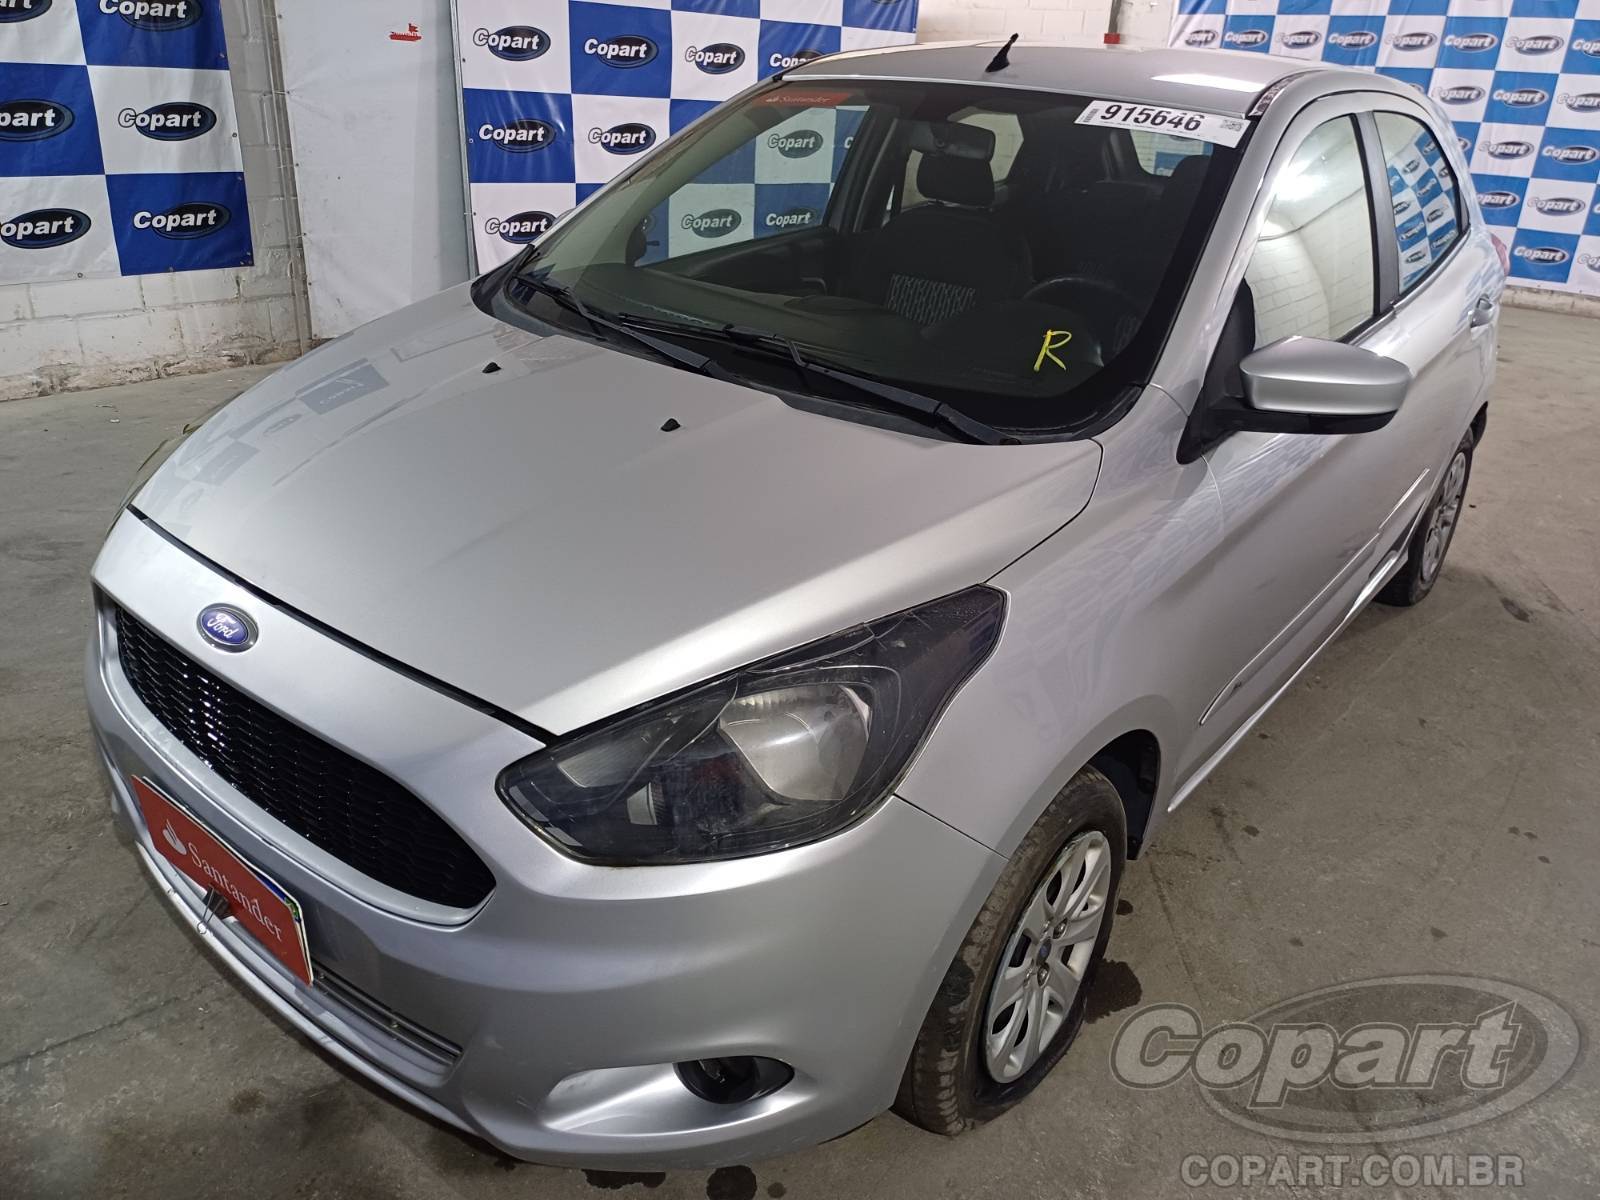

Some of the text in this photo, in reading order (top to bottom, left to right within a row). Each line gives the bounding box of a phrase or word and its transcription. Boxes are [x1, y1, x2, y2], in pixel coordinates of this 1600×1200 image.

[100, 0, 187, 19] Copart
[473, 28, 540, 50] Copart
[584, 38, 648, 59] Copart
[1329, 33, 1374, 46] Copart
[1445, 34, 1492, 48] Copart
[685, 46, 737, 65] Copart
[1493, 89, 1542, 104] Copart
[118, 108, 201, 131] Copart
[1100, 104, 1205, 131] 915646
[479, 124, 545, 142] Copart
[588, 127, 647, 146] Copart
[767, 133, 815, 149] Copart
[1542, 145, 1593, 160] Copart
[133, 209, 216, 232] Copart
[485, 217, 548, 237] Copart
[681, 213, 734, 233] Copart
[765, 212, 811, 227] Copart
[1514, 245, 1563, 261] Copart
[1033, 329, 1072, 371] R
[207, 612, 239, 639] Ford
[187, 841, 282, 943] Santander
